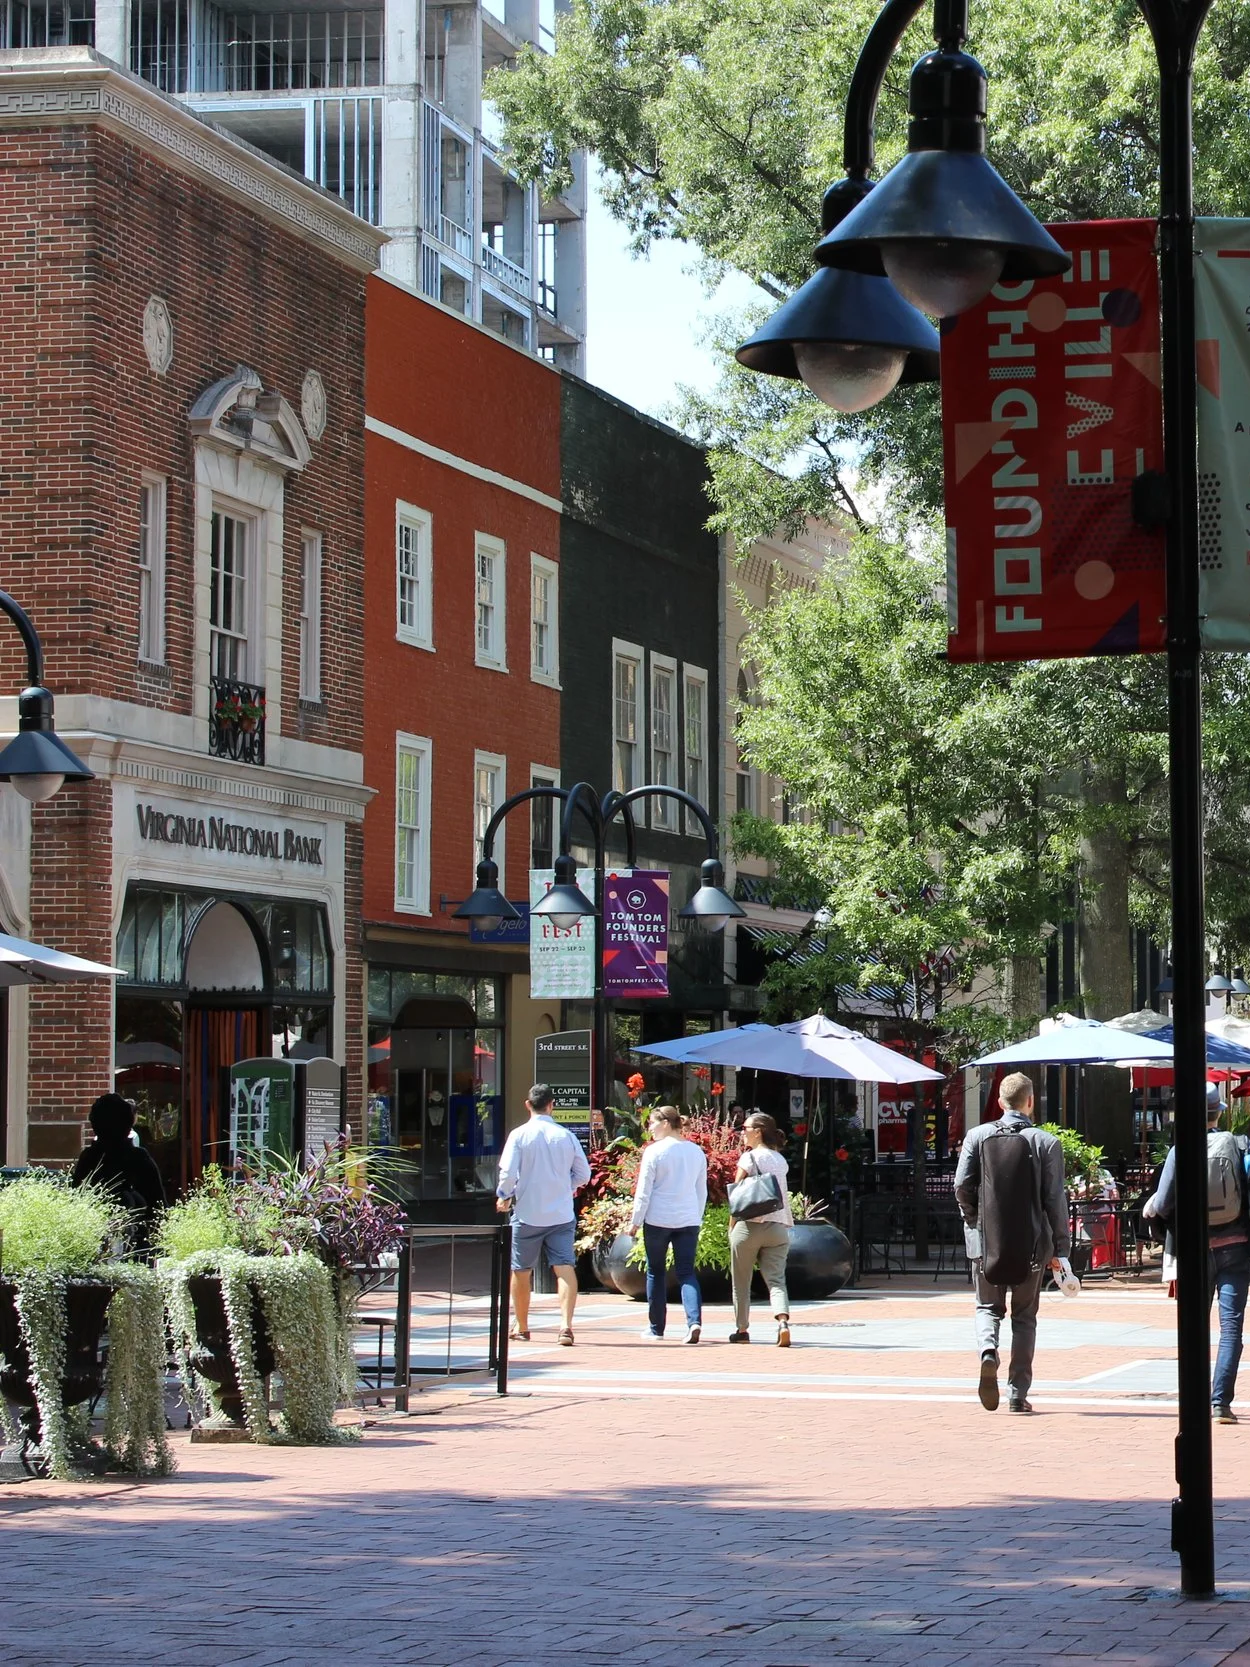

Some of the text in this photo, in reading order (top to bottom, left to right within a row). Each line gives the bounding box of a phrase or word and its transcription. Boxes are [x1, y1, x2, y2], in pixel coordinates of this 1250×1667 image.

[1234, 422, 1245, 433] A
[136, 803, 323, 865] VIRGINIA NATIONAL BANK
[610, 912, 662, 922] TOM TOM
[542, 922, 583, 938] FEST
[606, 922, 666, 933] FOUNDERS
[611, 933, 661, 943] FESTIVAL
[538, 1043, 553, 1051] 3rd
[557, 1087, 587, 1095] CAPITAL
